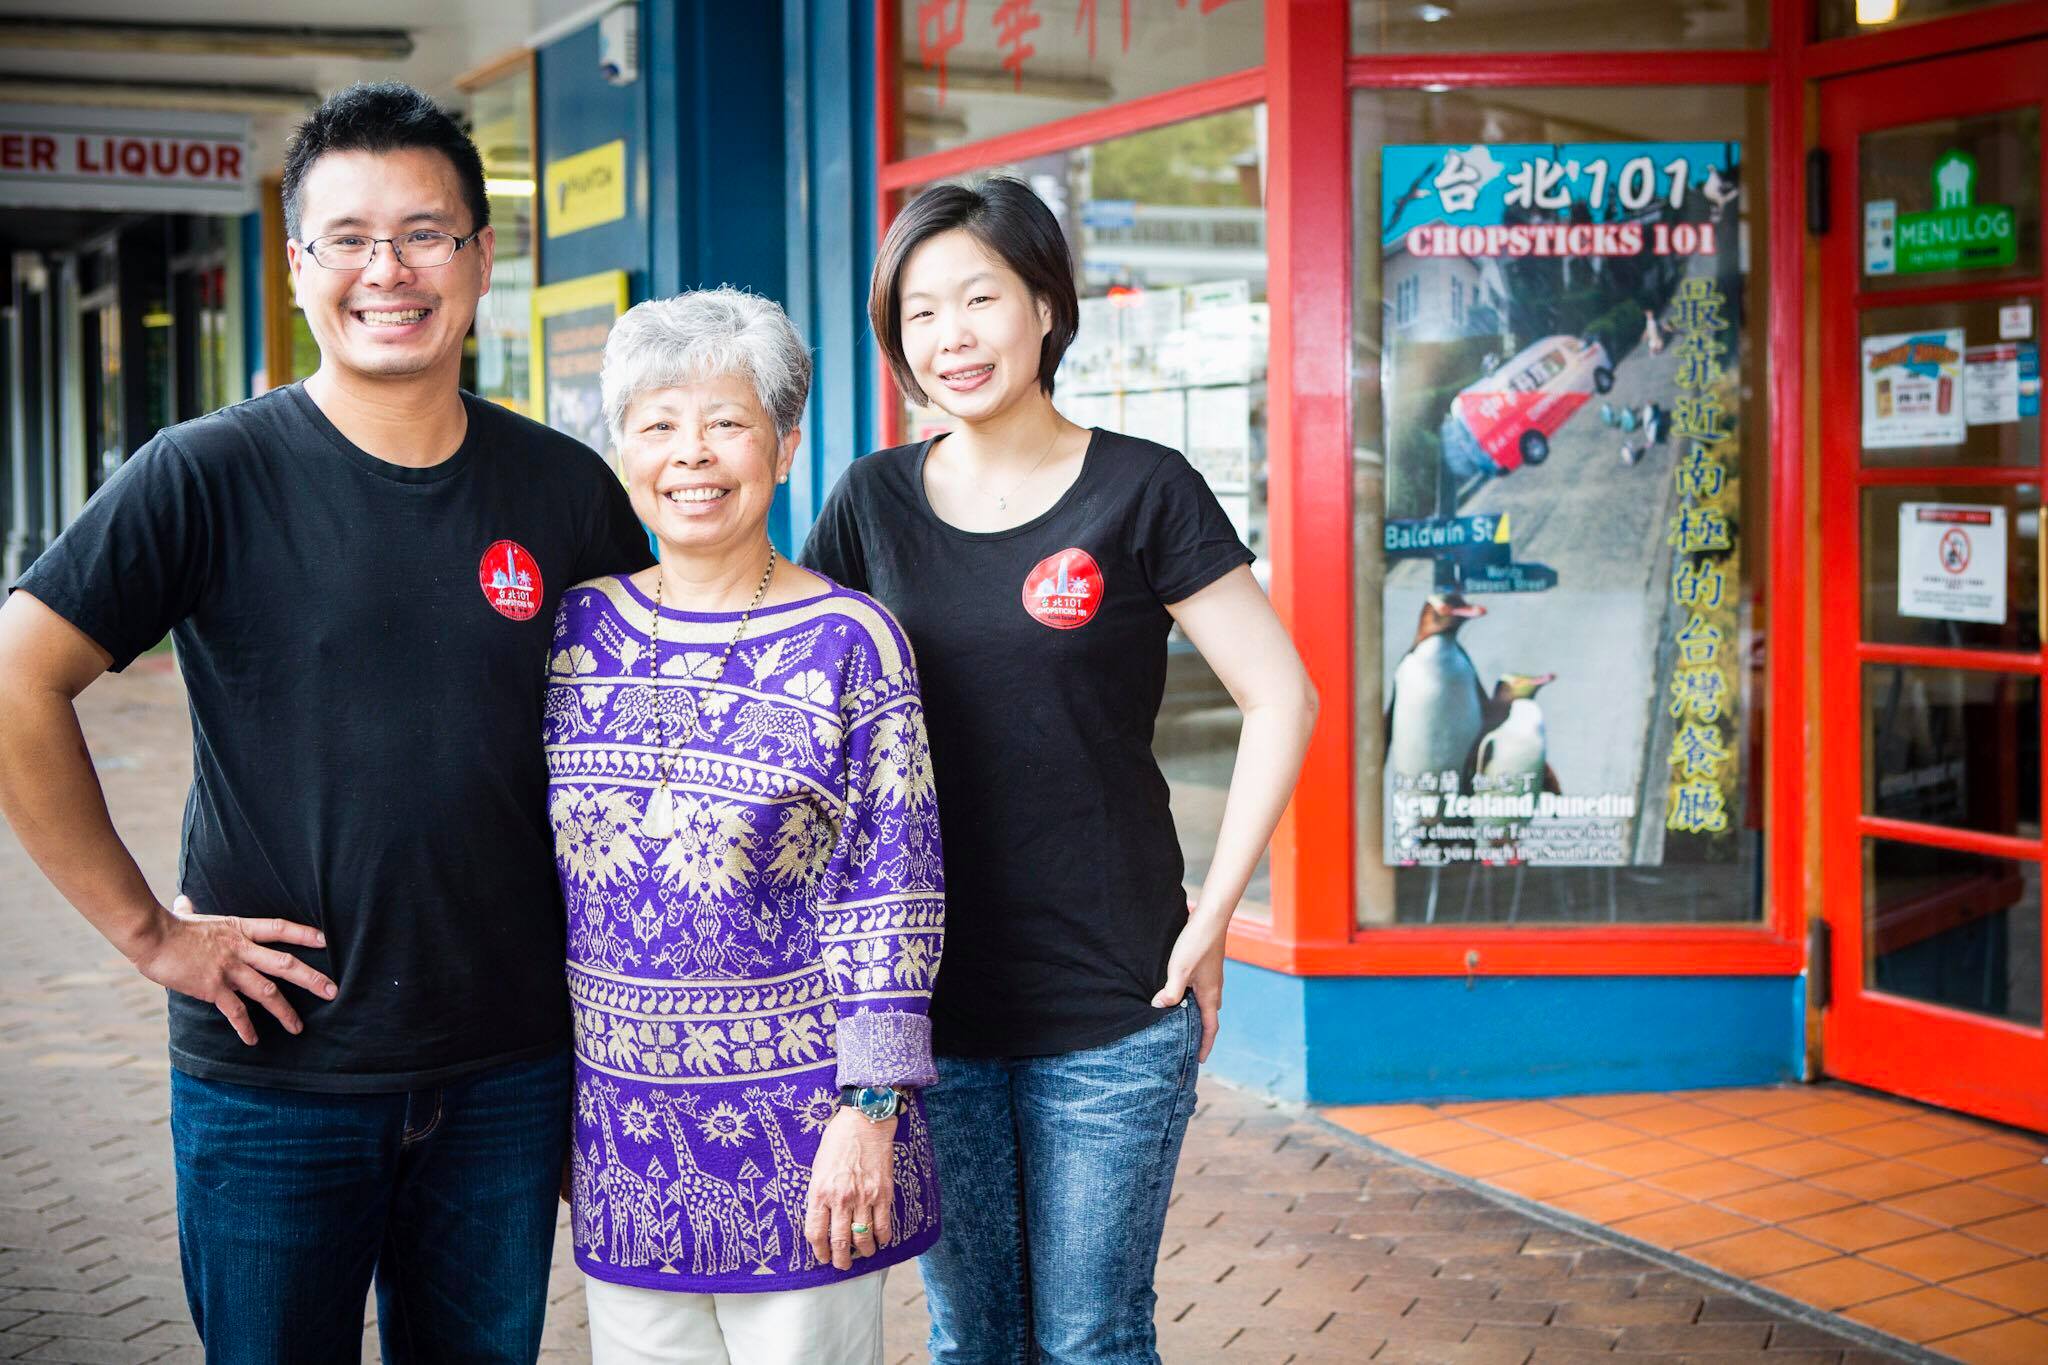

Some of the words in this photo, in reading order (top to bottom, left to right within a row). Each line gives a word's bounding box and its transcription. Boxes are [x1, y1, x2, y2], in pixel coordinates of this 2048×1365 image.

[0, 134, 58, 173] ER
[77, 137, 242, 179] LIQUOR
[1407, 223, 1643, 257] CHOPSTICKS
[1652, 222, 1717, 256] 101
[1899, 211, 2010, 248] MENULOG
[1384, 520, 1465, 550] Baldwin
[1471, 516, 1493, 543] St
[1037, 607, 1077, 615] CHOPSTICKS
[1392, 793, 1441, 818] New
[1428, 823, 1478, 841] chance
[1482, 823, 1505, 840] for
[1443, 844, 1473, 864] you
